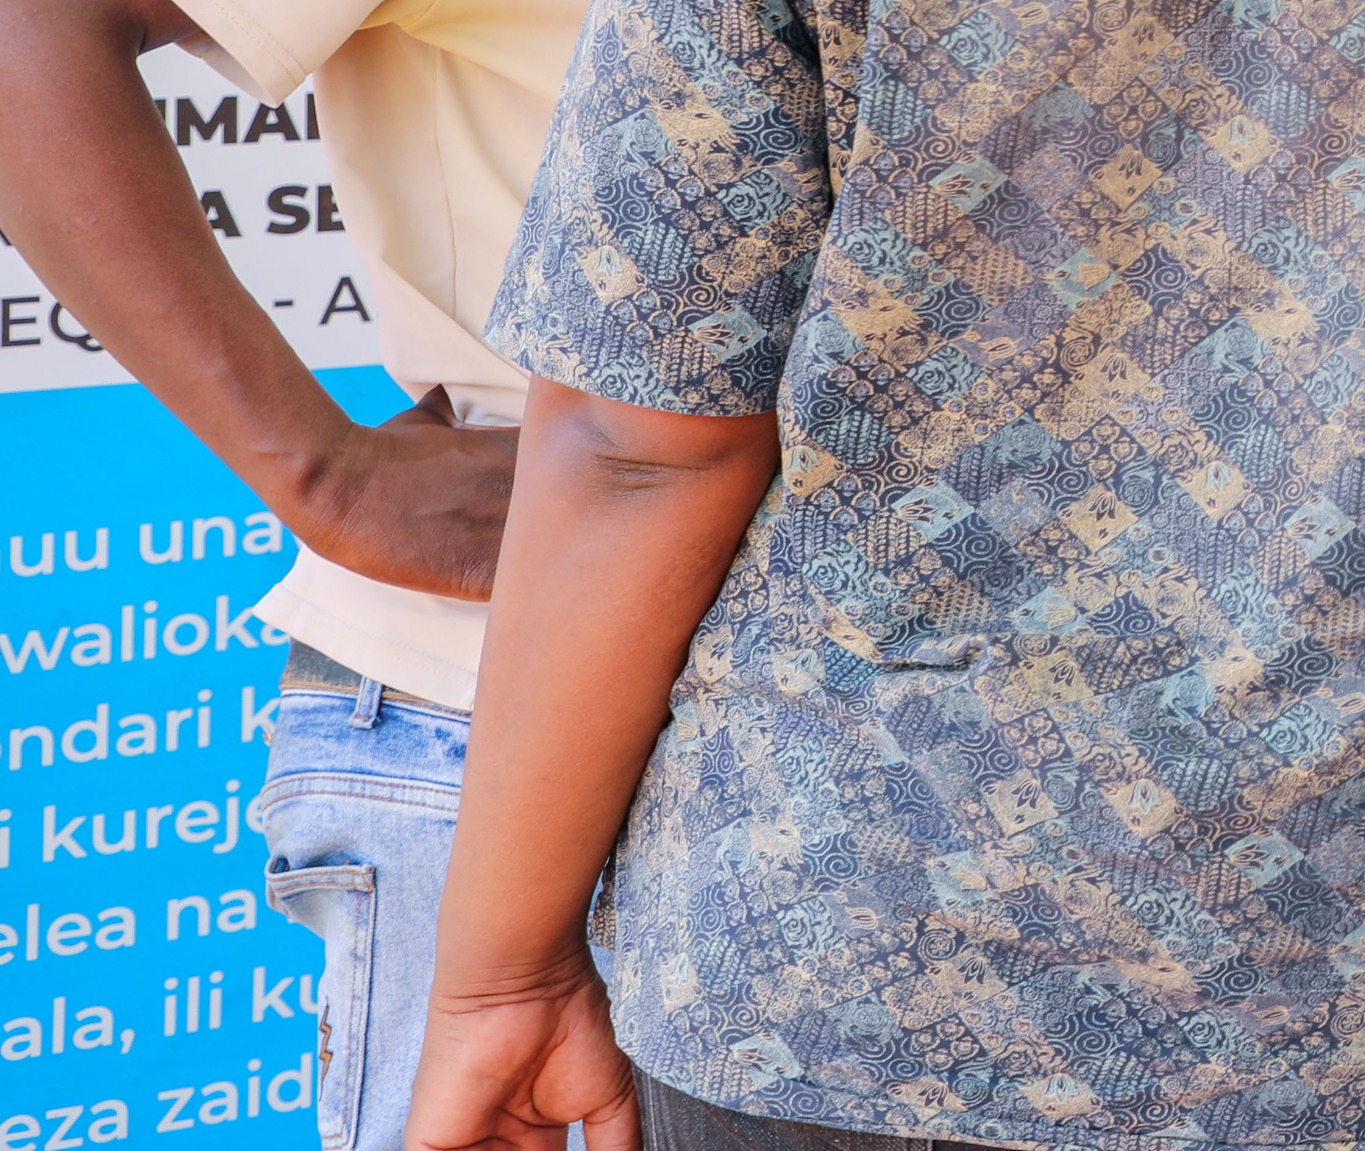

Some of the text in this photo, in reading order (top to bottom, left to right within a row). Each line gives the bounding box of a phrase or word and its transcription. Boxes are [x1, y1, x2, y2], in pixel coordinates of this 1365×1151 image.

[319, 275, 371, 325] A
[10, 511, 284, 577] uu una
[0, 689, 212, 771] ndari
[167, 889, 257, 941] na
[0, 996, 135, 1061] ala,
[164, 970, 225, 1037] ili
[156, 1052, 314, 1134] zaid
